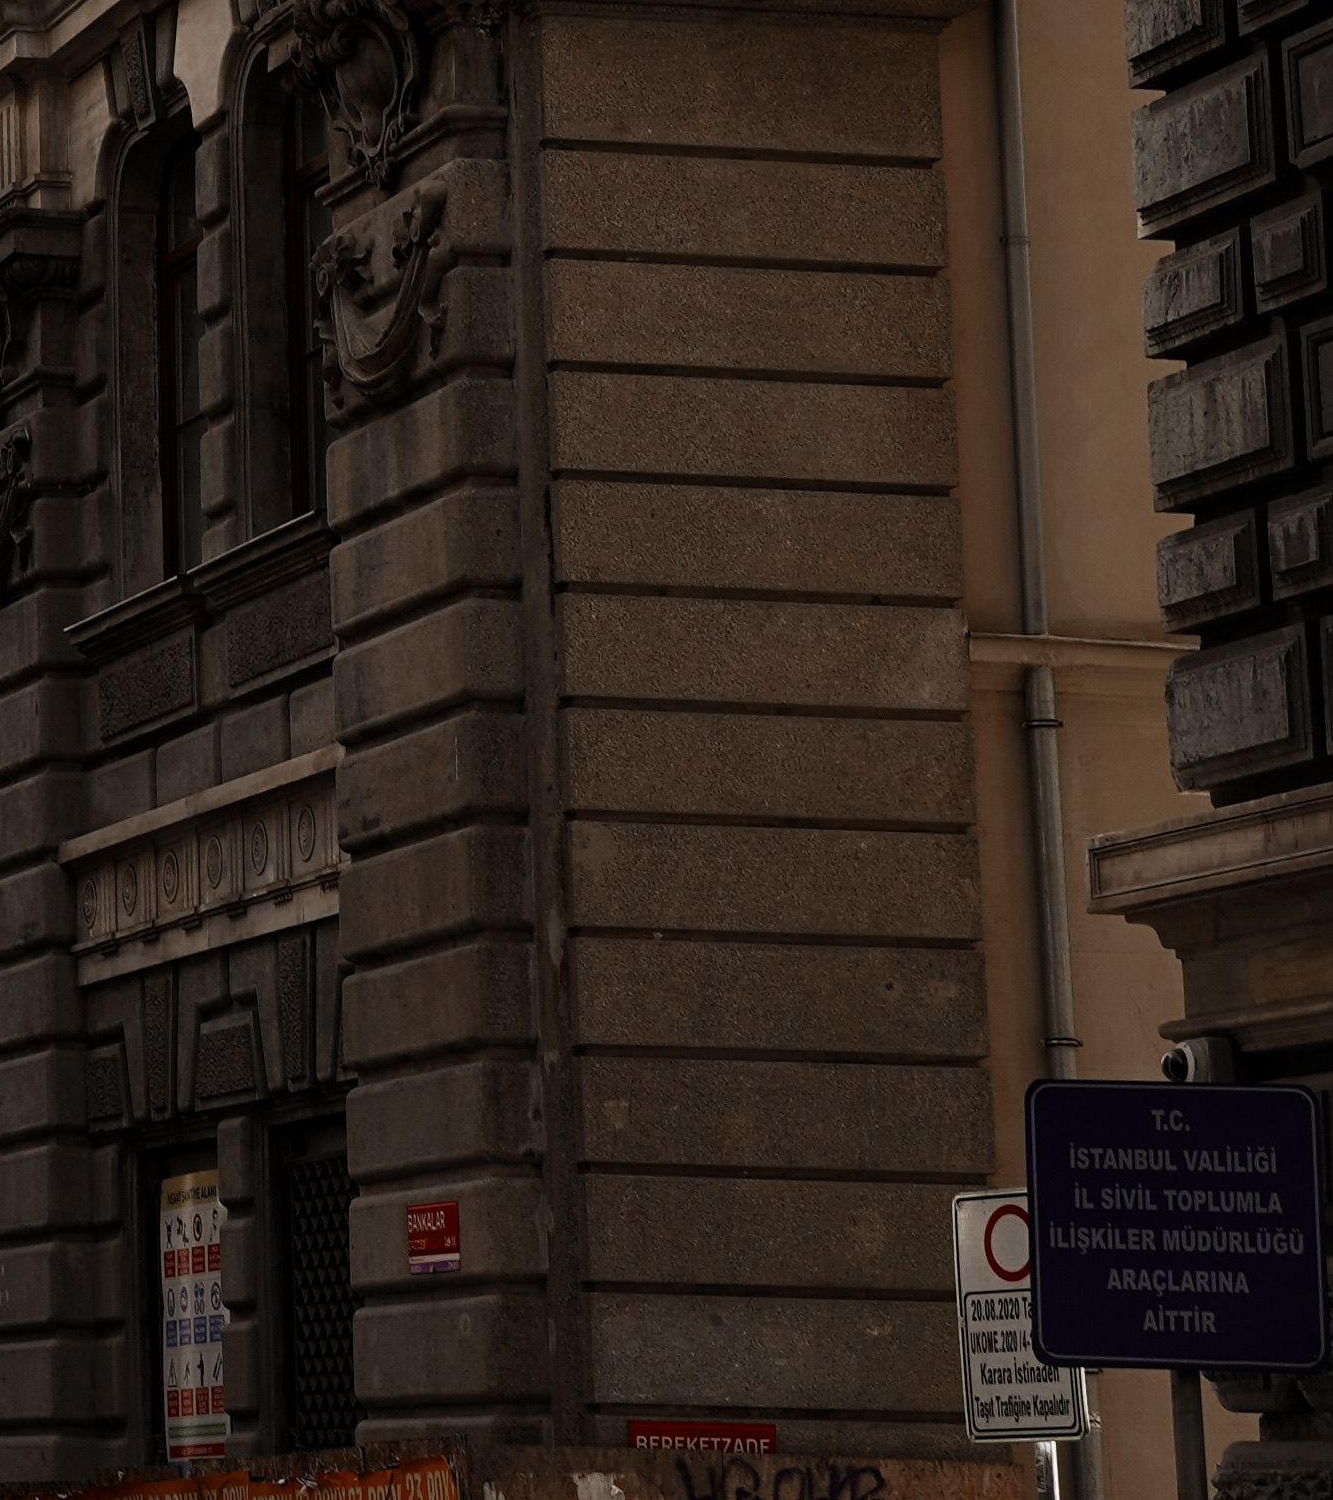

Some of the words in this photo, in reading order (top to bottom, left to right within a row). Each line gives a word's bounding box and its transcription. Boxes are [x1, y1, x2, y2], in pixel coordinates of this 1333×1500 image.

[1151, 1109, 1190, 1131] T.C.
[1069, 1142, 1177, 1172] İSTANBUL
[1183, 1145, 1277, 1174] VALİLİĞİ
[1074, 1182, 1094, 1209] İL
[1101, 1183, 1157, 1211] SİVİL
[1163, 1189, 1283, 1214] TOPLUMLA
[408, 1210, 445, 1233] BANKALAR
[1049, 1221, 1156, 1255] İLİŞKİLER
[1162, 1225, 1304, 1255] MÜDÜRLÜĞÜ
[1107, 1268, 1250, 1296] ARAÇLARINA
[971, 1298, 1020, 1321] 20.08.2020
[1143, 1304, 1217, 1333] AİTTİR
[980, 1362, 1012, 1385] Karara
[1014, 1357, 1060, 1384] İstinaden
[975, 1397, 994, 1422] Taşıt
[996, 1394, 1031, 1422] Trafiğine
[1033, 1394, 1070, 1420] Kapalıdır
